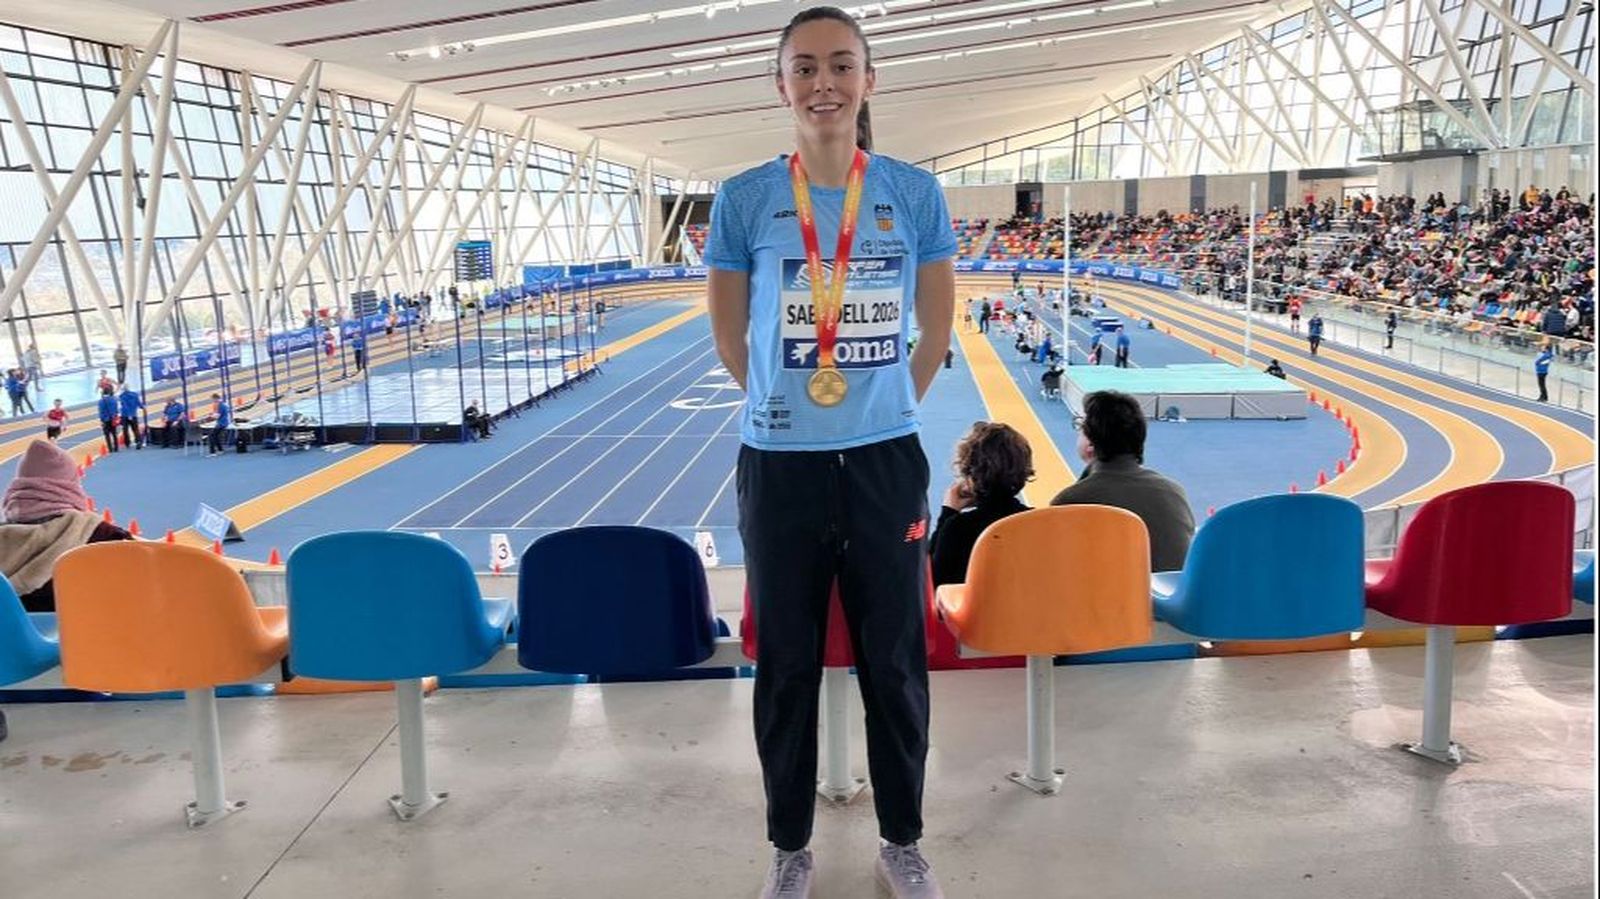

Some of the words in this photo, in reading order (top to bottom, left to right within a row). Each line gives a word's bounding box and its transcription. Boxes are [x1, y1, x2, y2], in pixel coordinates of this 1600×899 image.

[786, 303, 869, 325] SABELL
[871, 300, 900, 323] 2026
[818, 339, 896, 363] oma
[498, 543, 509, 560] 3
[705, 542, 714, 558] 6
